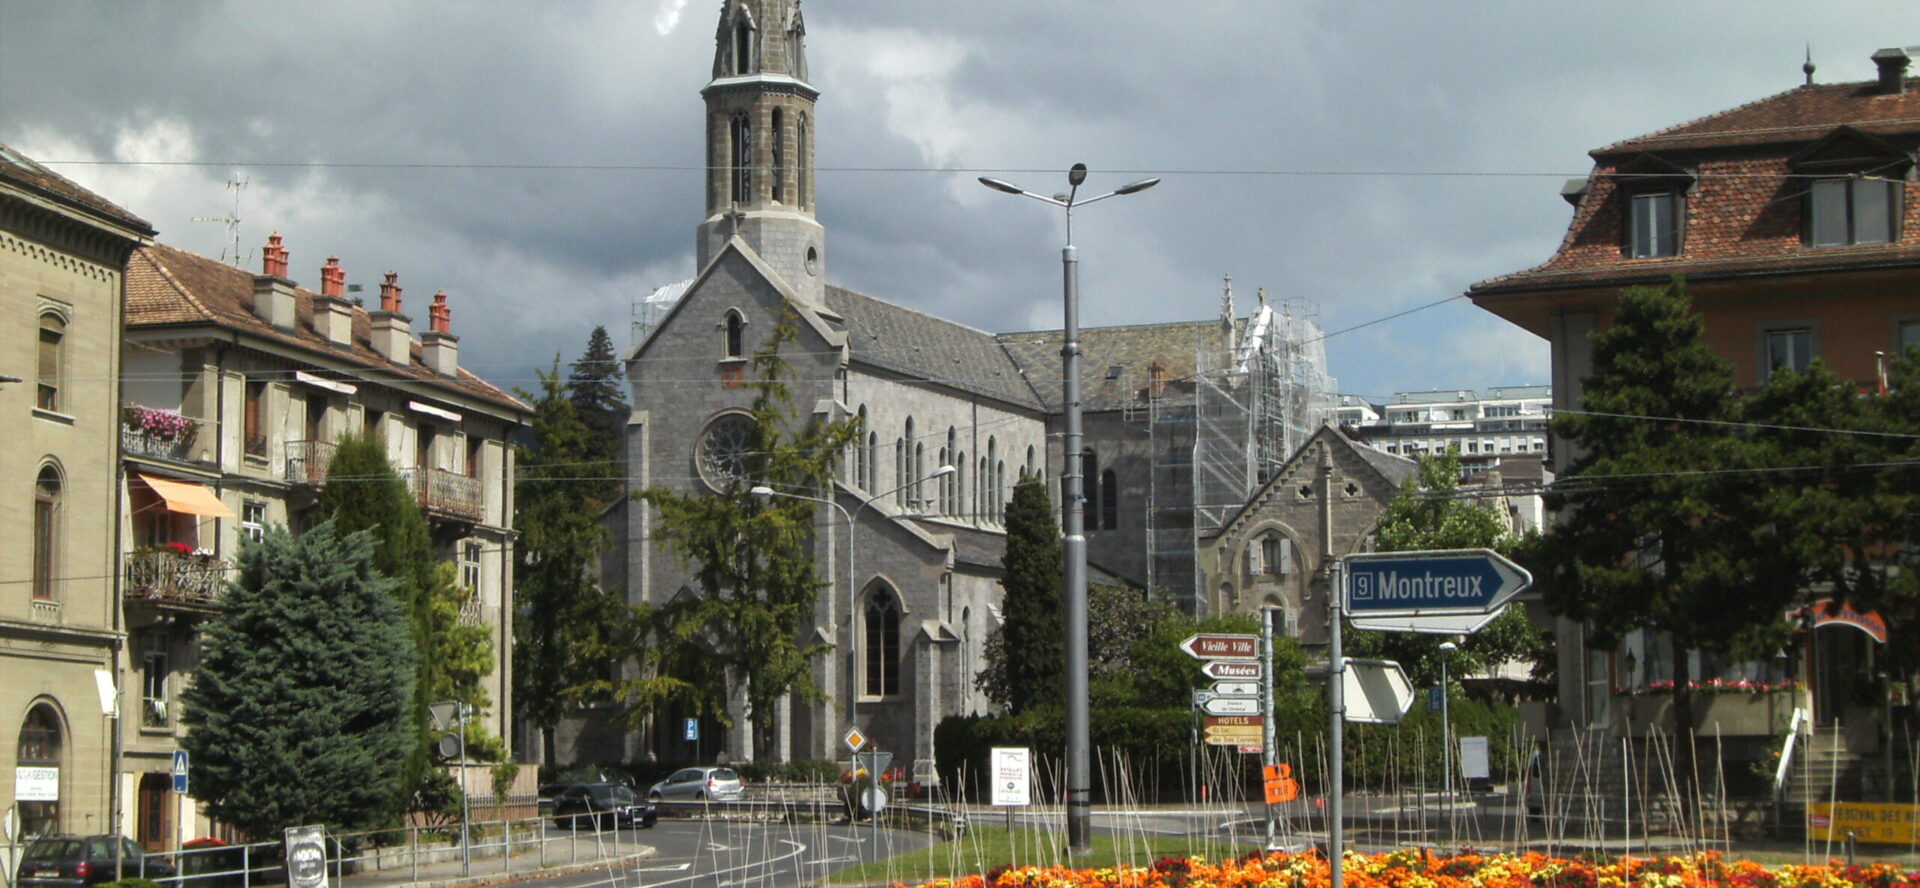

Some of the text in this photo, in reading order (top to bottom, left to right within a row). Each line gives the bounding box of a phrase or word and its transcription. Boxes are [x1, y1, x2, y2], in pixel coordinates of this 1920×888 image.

[1358, 571, 1483, 600] 9 Montreux
[1201, 641, 1253, 652] Vieille Ville
[1217, 665, 1257, 676] Musées
[1218, 717, 1249, 725] HOTELS
[1880, 809, 1901, 822] DES
